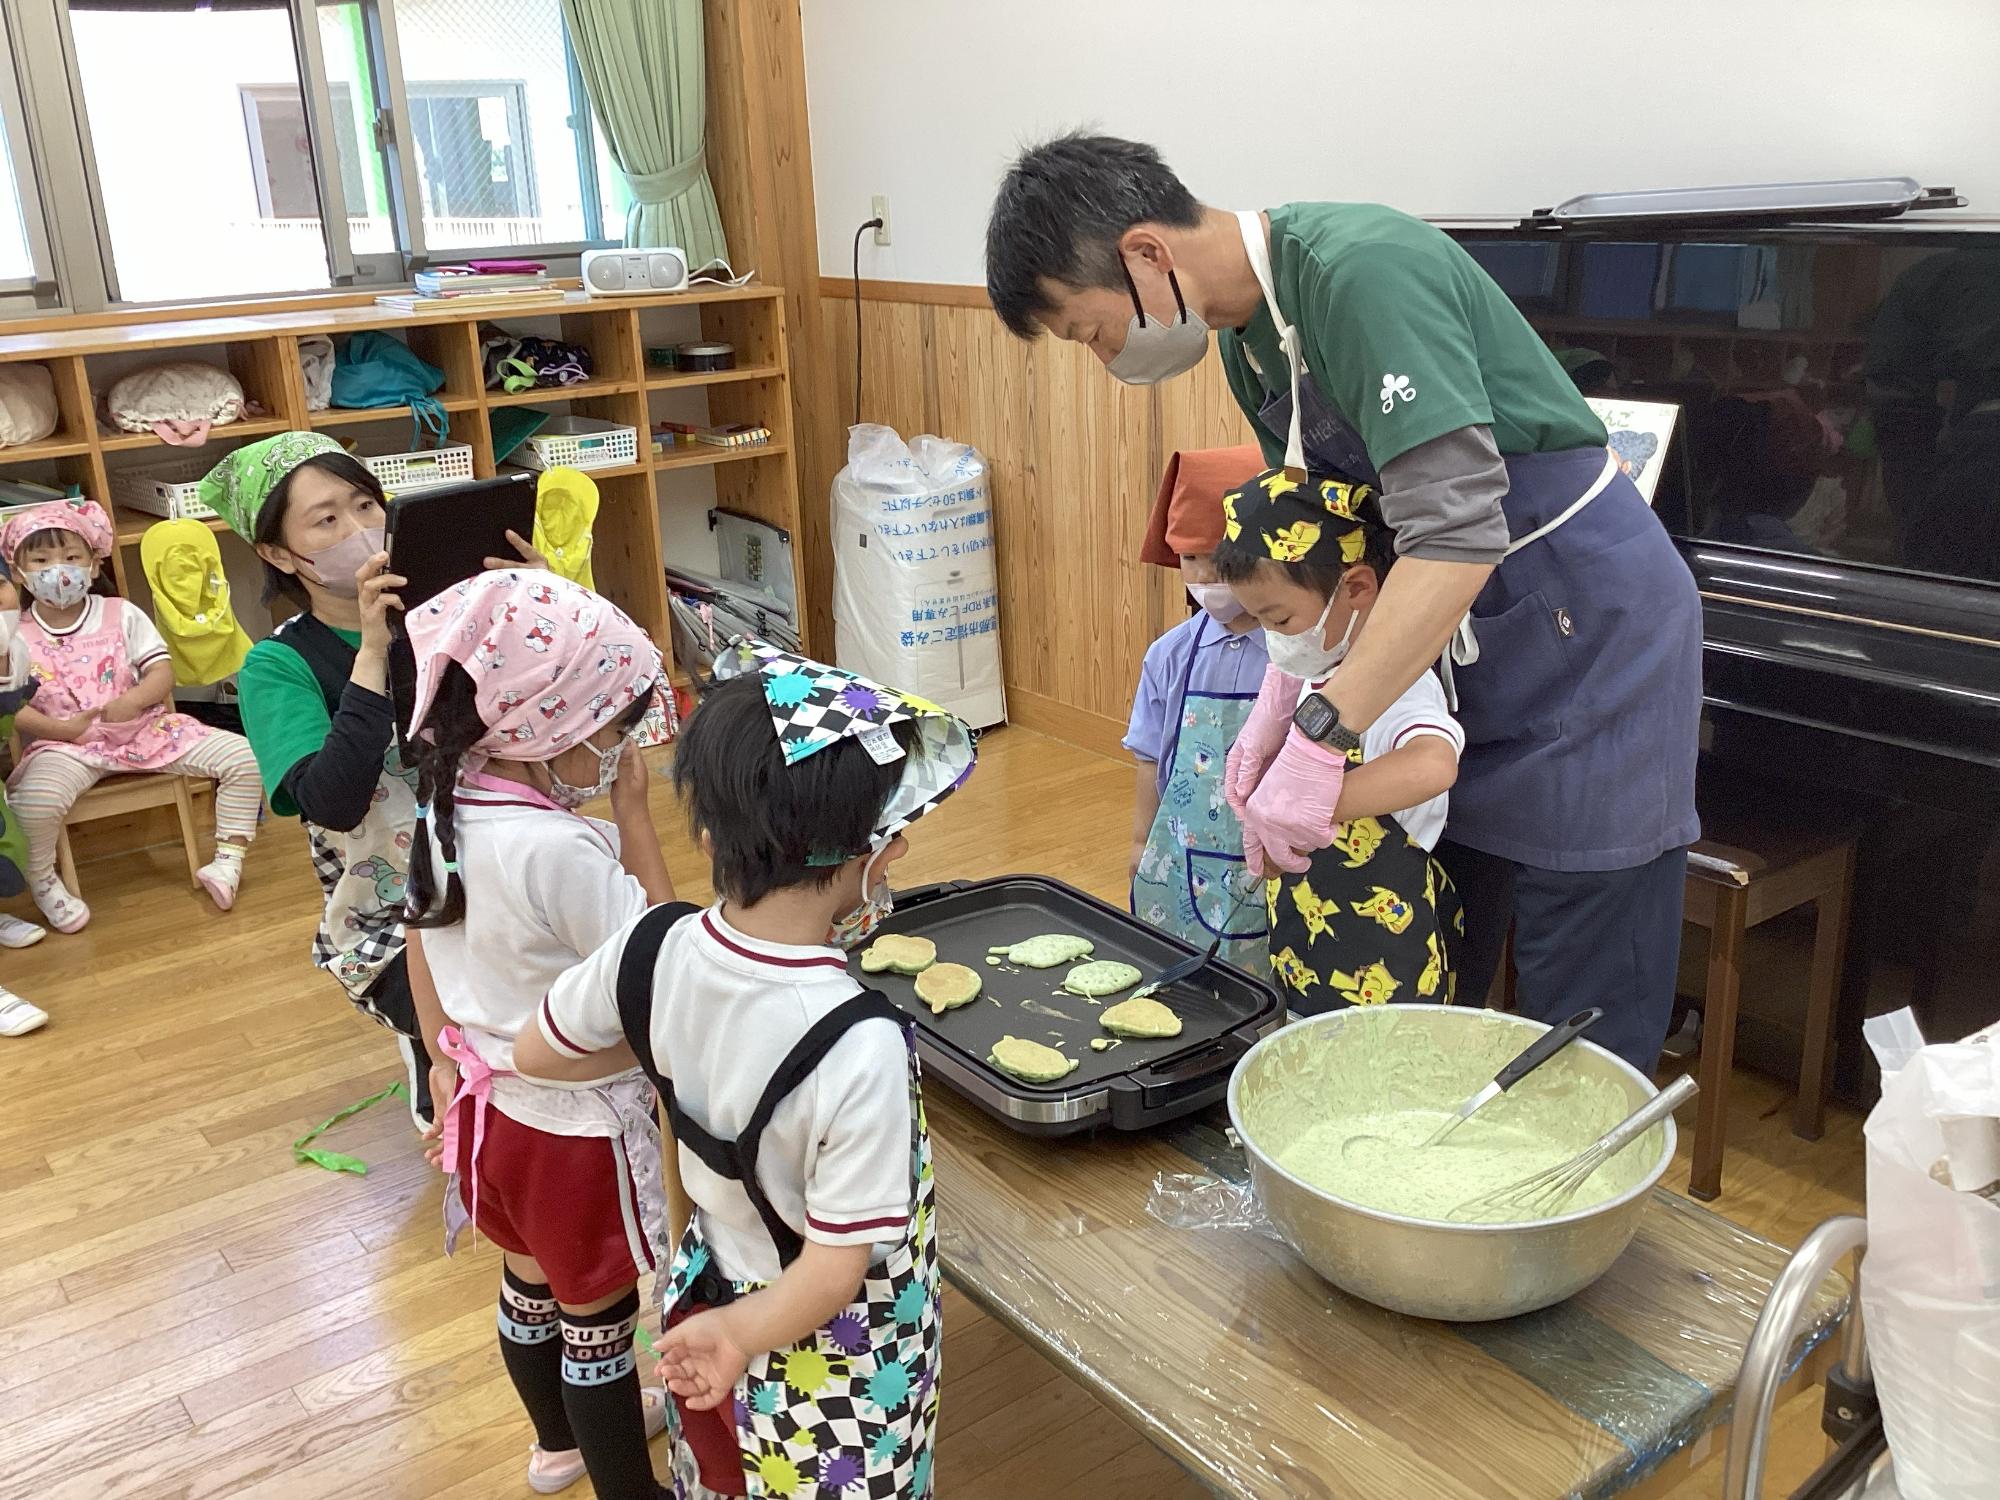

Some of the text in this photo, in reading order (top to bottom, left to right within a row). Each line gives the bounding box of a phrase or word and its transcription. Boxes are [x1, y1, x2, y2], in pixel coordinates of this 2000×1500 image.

[882, 487, 987, 511] ド類は50センチ以下に
[513, 1296, 559, 1310] CUT
[510, 1322, 560, 1340] LIK
[564, 1321, 630, 1342] CUTE
[565, 1357, 627, 1380] LIKE
